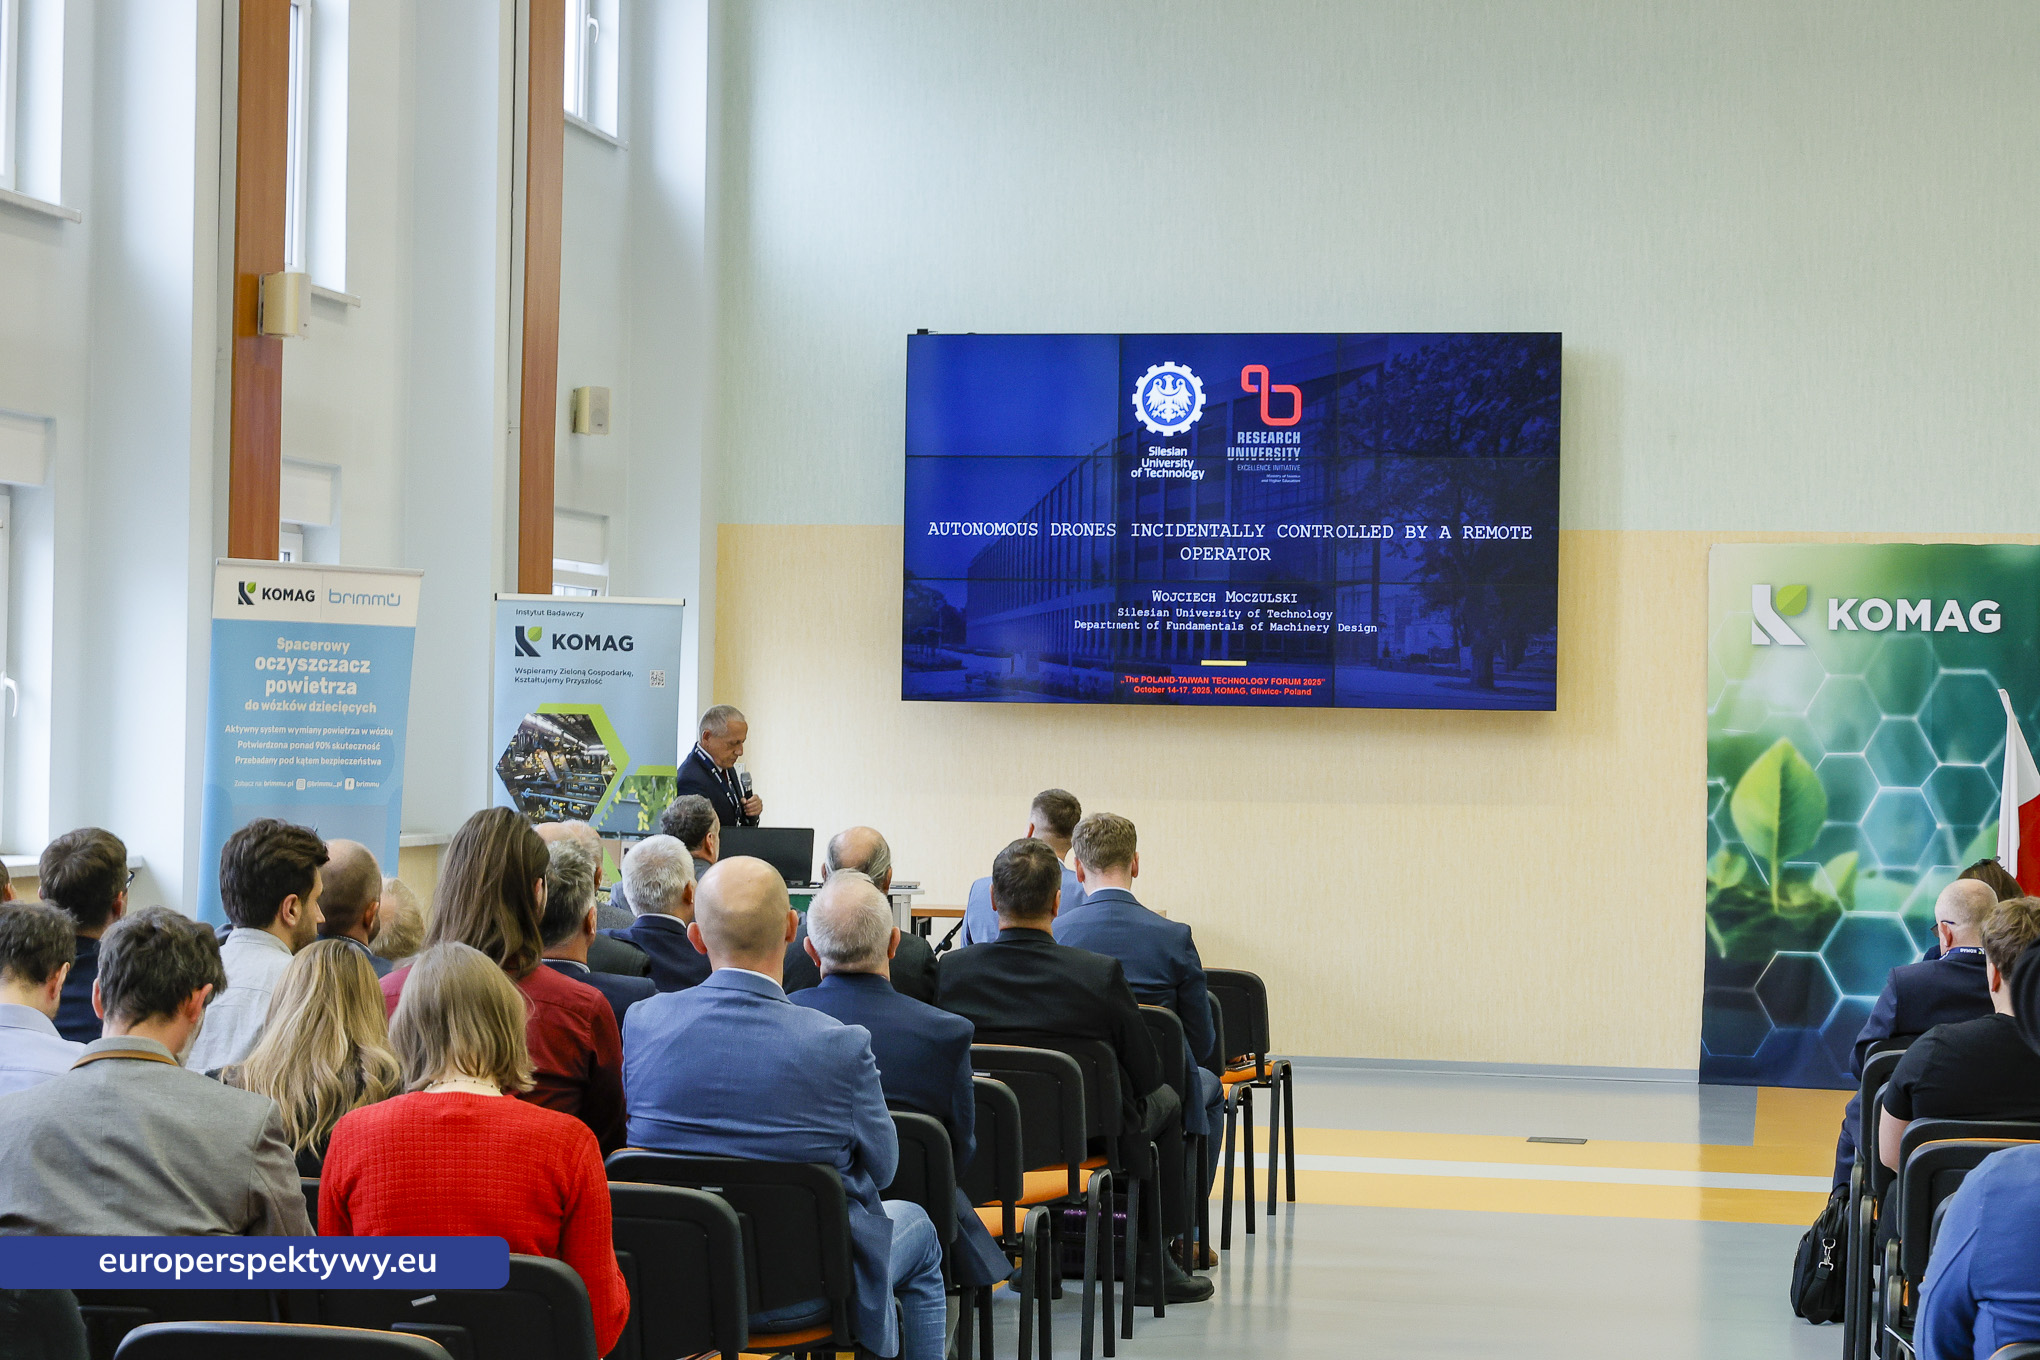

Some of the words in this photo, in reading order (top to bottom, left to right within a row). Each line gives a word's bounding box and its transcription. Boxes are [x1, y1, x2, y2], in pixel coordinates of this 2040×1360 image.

[1237, 431, 1301, 444] RESEARCH
[1148, 446, 1188, 456] Silesian
[1227, 447, 1301, 461] UNIVERSITY
[1141, 458, 1194, 470] University
[1130, 469, 1142, 478] of
[1144, 467, 1205, 480] Technology
[928, 522, 1038, 536] AUTONOMOUS
[1050, 523, 1116, 537] DRONES
[1131, 524, 1265, 538] INCIDENTALLY
[1277, 524, 1394, 539] CONTROLLED
[1404, 526, 1428, 539] BY
[1439, 526, 1452, 539] A
[1462, 526, 1533, 540] REMOTE
[1180, 546, 1272, 562] OPERATOR
[262, 587, 316, 602] KOMAG
[1152, 590, 1216, 603] WOJCIECH
[1225, 590, 1298, 604] MOCZULSKI
[516, 608, 545, 617] Instytut
[546, 609, 584, 618] Badawczy
[1118, 607, 1170, 618] Silesian
[1176, 608, 1241, 620] University
[1247, 609, 1261, 619] of
[1267, 609, 1333, 621] Technology
[1828, 598, 2002, 634] KOMAG
[1074, 620, 1140, 632] Department
[1146, 620, 1160, 630] of
[1166, 621, 1244, 632] Fundamentals
[1250, 622, 1264, 632] of
[1270, 622, 1330, 634] Machinery
[1338, 623, 1378, 634] Design
[276, 637, 350, 654] Spacerowy
[552, 633, 634, 652] KOMAG
[254, 656, 371, 675] oczyszczacz
[514, 667, 557, 676] Wspieramy
[560, 668, 586, 677] Zieloną
[588, 669, 634, 678] Gospodarkę,
[266, 676, 358, 697] powietrza
[514, 676, 564, 685] Kształtujemy
[566, 677, 602, 686] Przyszłość
[1140, 676, 1210, 684] POLAND-TAIWAN
[1212, 677, 1269, 685] TECHNOLOGY
[1270, 678, 1301, 686] FORUM
[1134, 686, 1166, 694] October
[1167, 686, 1190, 694] 14-17,
[1192, 686, 1212, 694] 2025,
[1214, 686, 1248, 695] KOMAG,
[1284, 688, 1312, 696] Poland
[244, 700, 260, 711] do
[262, 700, 307, 712] wózków
[308, 700, 377, 715] dziecięcych
[225, 724, 258, 735] Aktywny
[260, 726, 286, 735] system
[288, 726, 322, 736] wymiany
[322, 727, 360, 736] powietrza
[370, 727, 394, 736] wózku
[238, 740, 288, 750] Potwierdzona
[290, 741, 314, 750] ponad
[316, 742, 330, 750] 90%
[332, 742, 381, 750] skuteczność
[234, 756, 278, 766] Przebadany
[278, 756, 294, 766] pod
[296, 756, 320, 766] kątem
[320, 756, 382, 766] bezpieczeństwa
